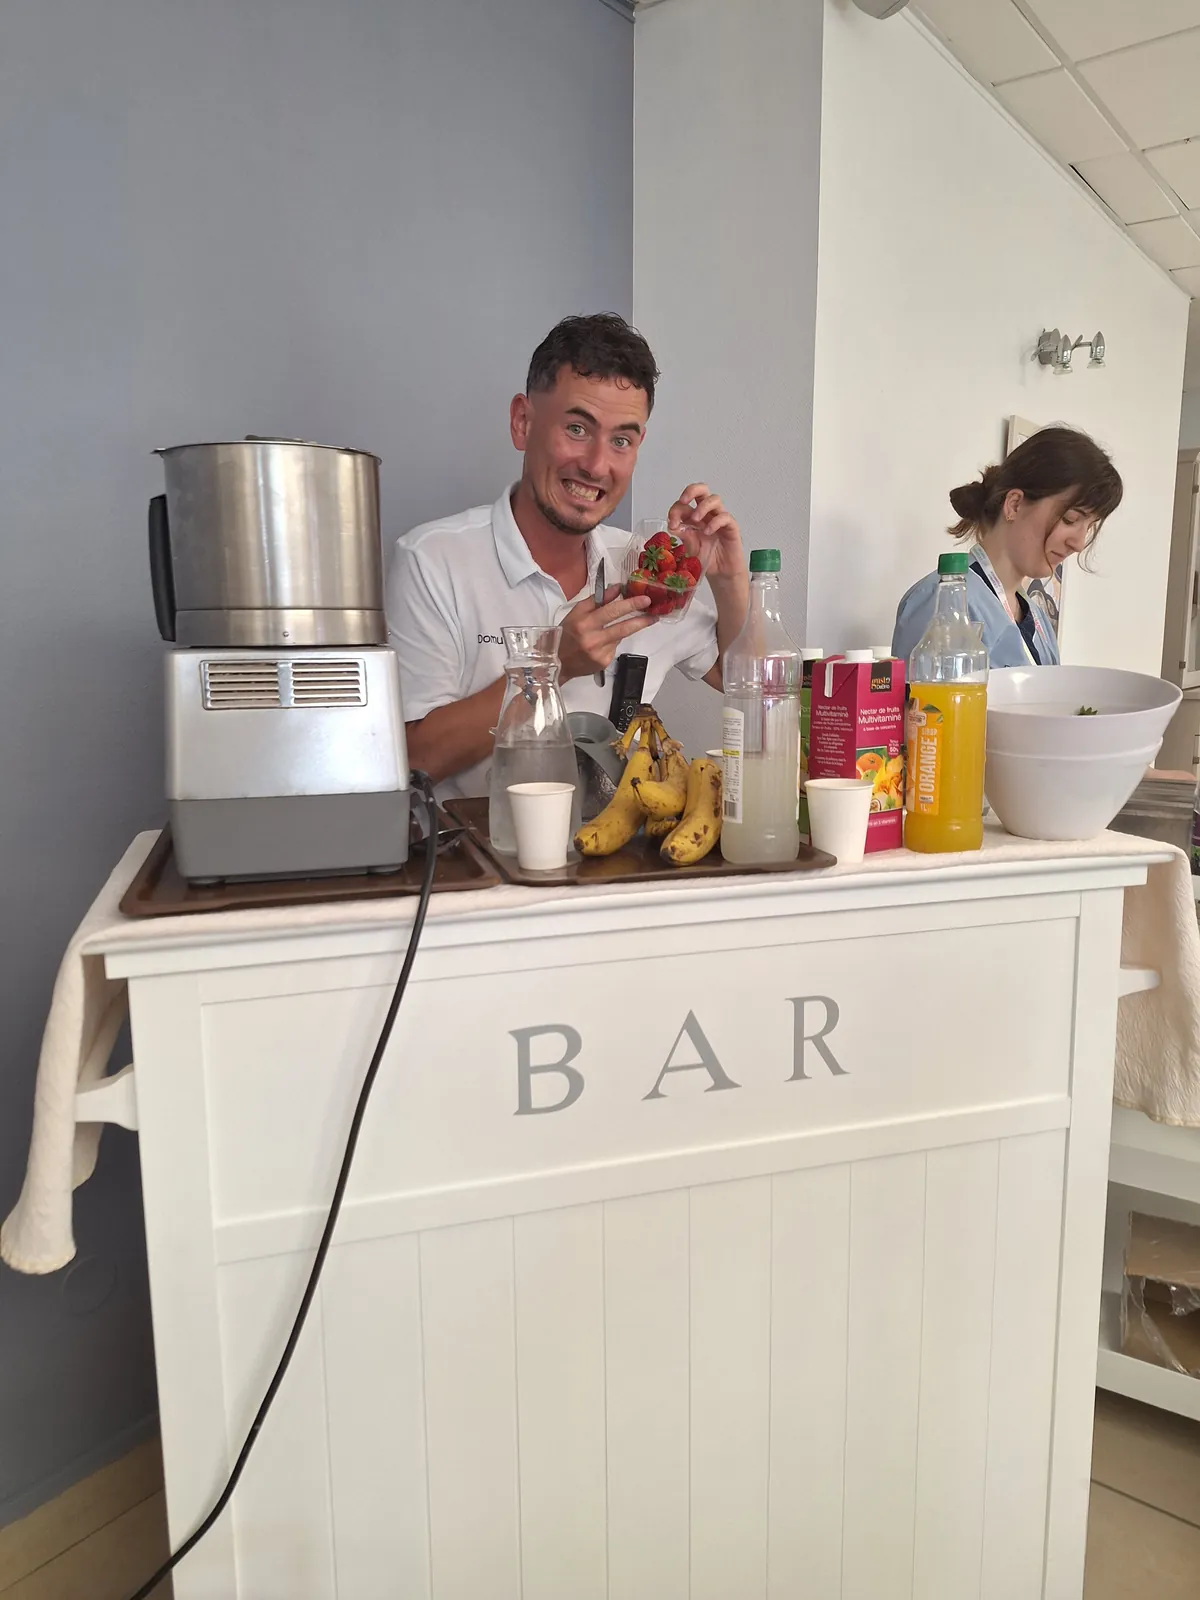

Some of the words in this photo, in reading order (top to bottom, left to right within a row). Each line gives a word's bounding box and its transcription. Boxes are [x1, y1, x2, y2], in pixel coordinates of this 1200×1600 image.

[858, 713, 902, 725] Multivitaminé
[860, 708, 877, 716] Nectar
[919, 737, 938, 793] ORANGE
[508, 995, 851, 1116] BAR
